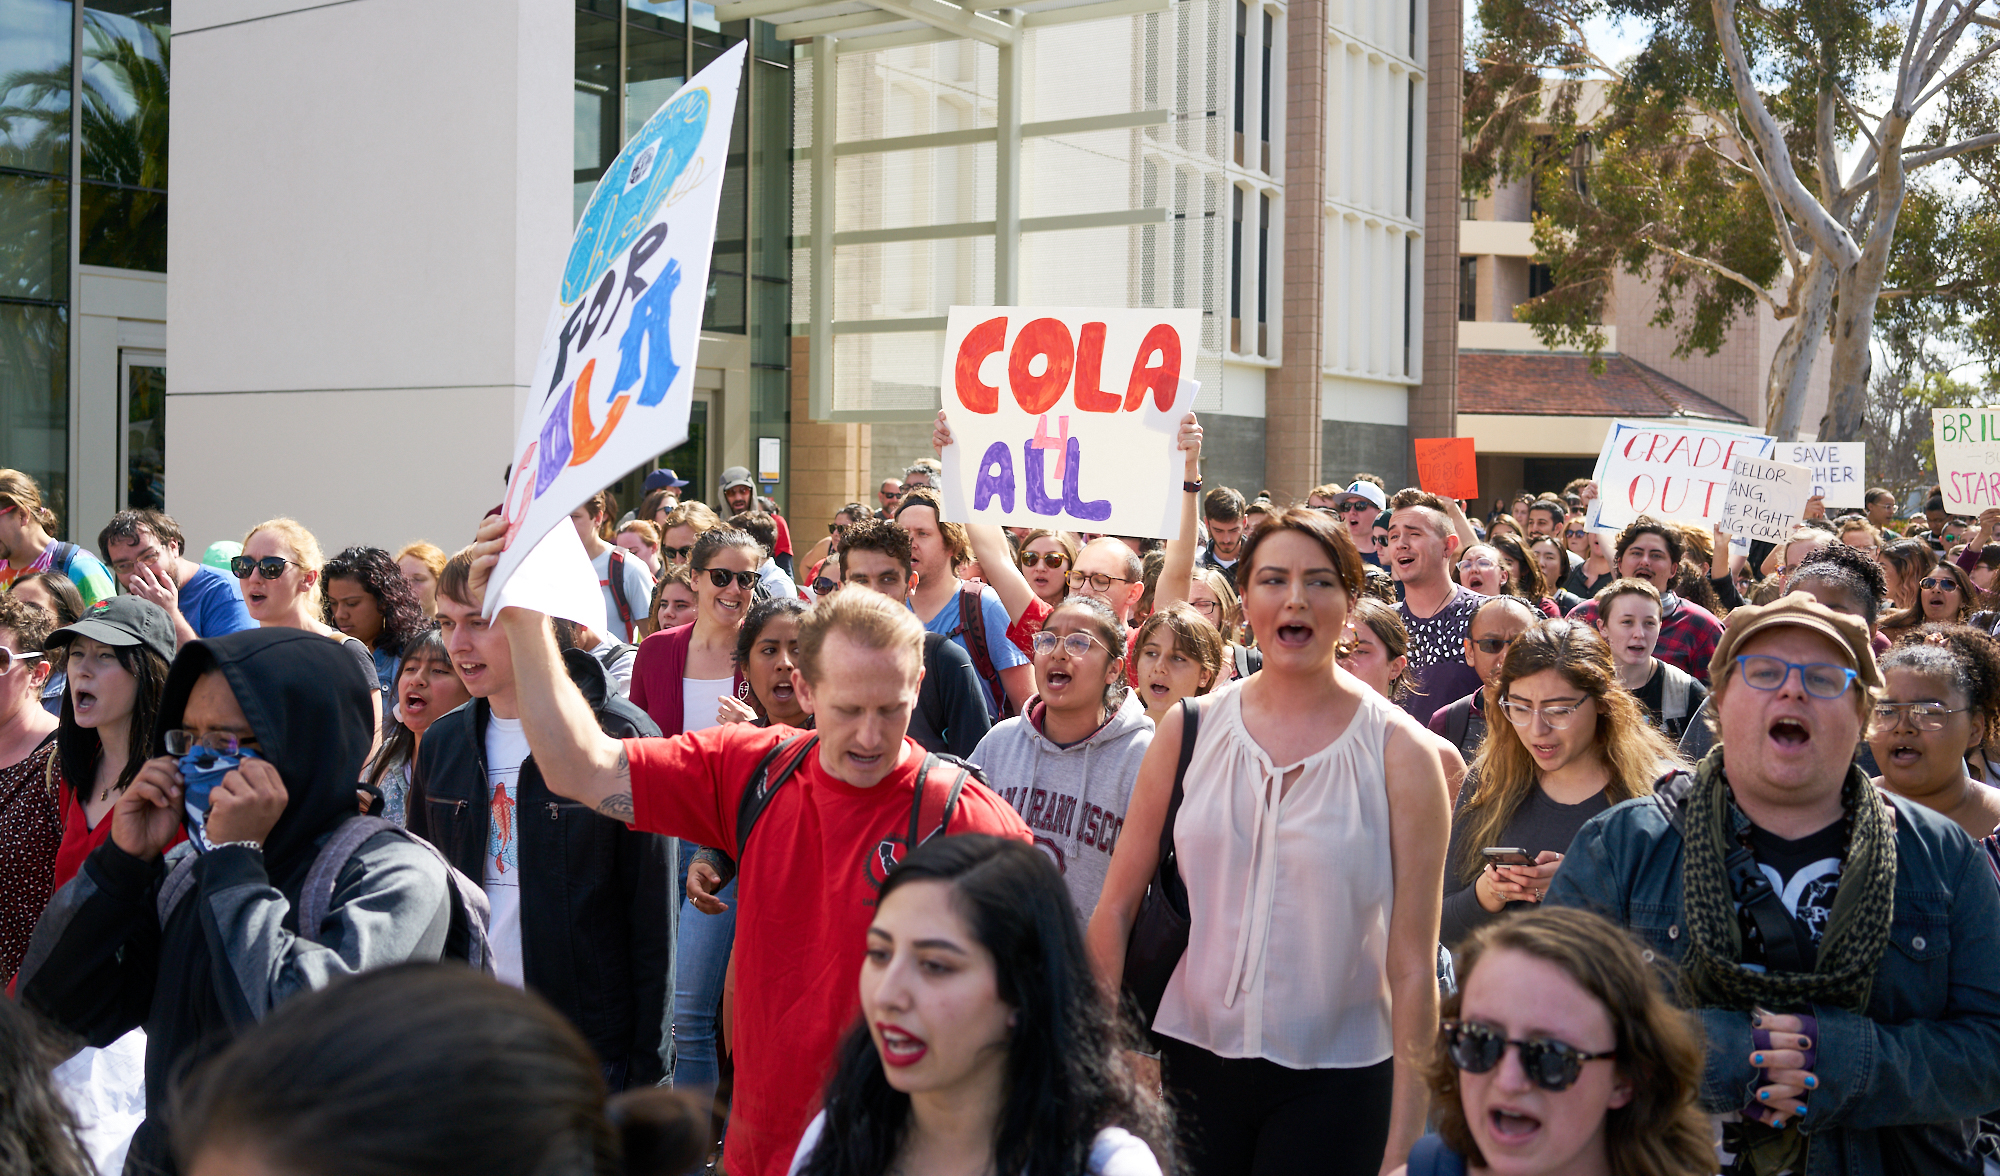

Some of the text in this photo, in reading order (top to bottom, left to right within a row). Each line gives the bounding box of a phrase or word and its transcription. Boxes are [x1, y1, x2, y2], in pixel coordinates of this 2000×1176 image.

[540, 221, 668, 414] FOR
[955, 316, 1182, 415] COLA
[502, 257, 682, 553] COLA
[1943, 413, 2000, 443] BRIL
[1031, 414, 1069, 480] 4
[1417, 438, 1462, 460] IN SOLIDARITY
[1431, 451, 1447, 461] WITH
[1623, 432, 1750, 471] GRADE
[1793, 446, 1840, 463] SAVE
[974, 436, 1112, 522] ALL
[1733, 460, 1792, 485] CELLOR
[1628, 474, 1728, 518] OUT
[1728, 479, 1766, 503] ANG.
[1743, 505, 1794, 528] RIGHT
